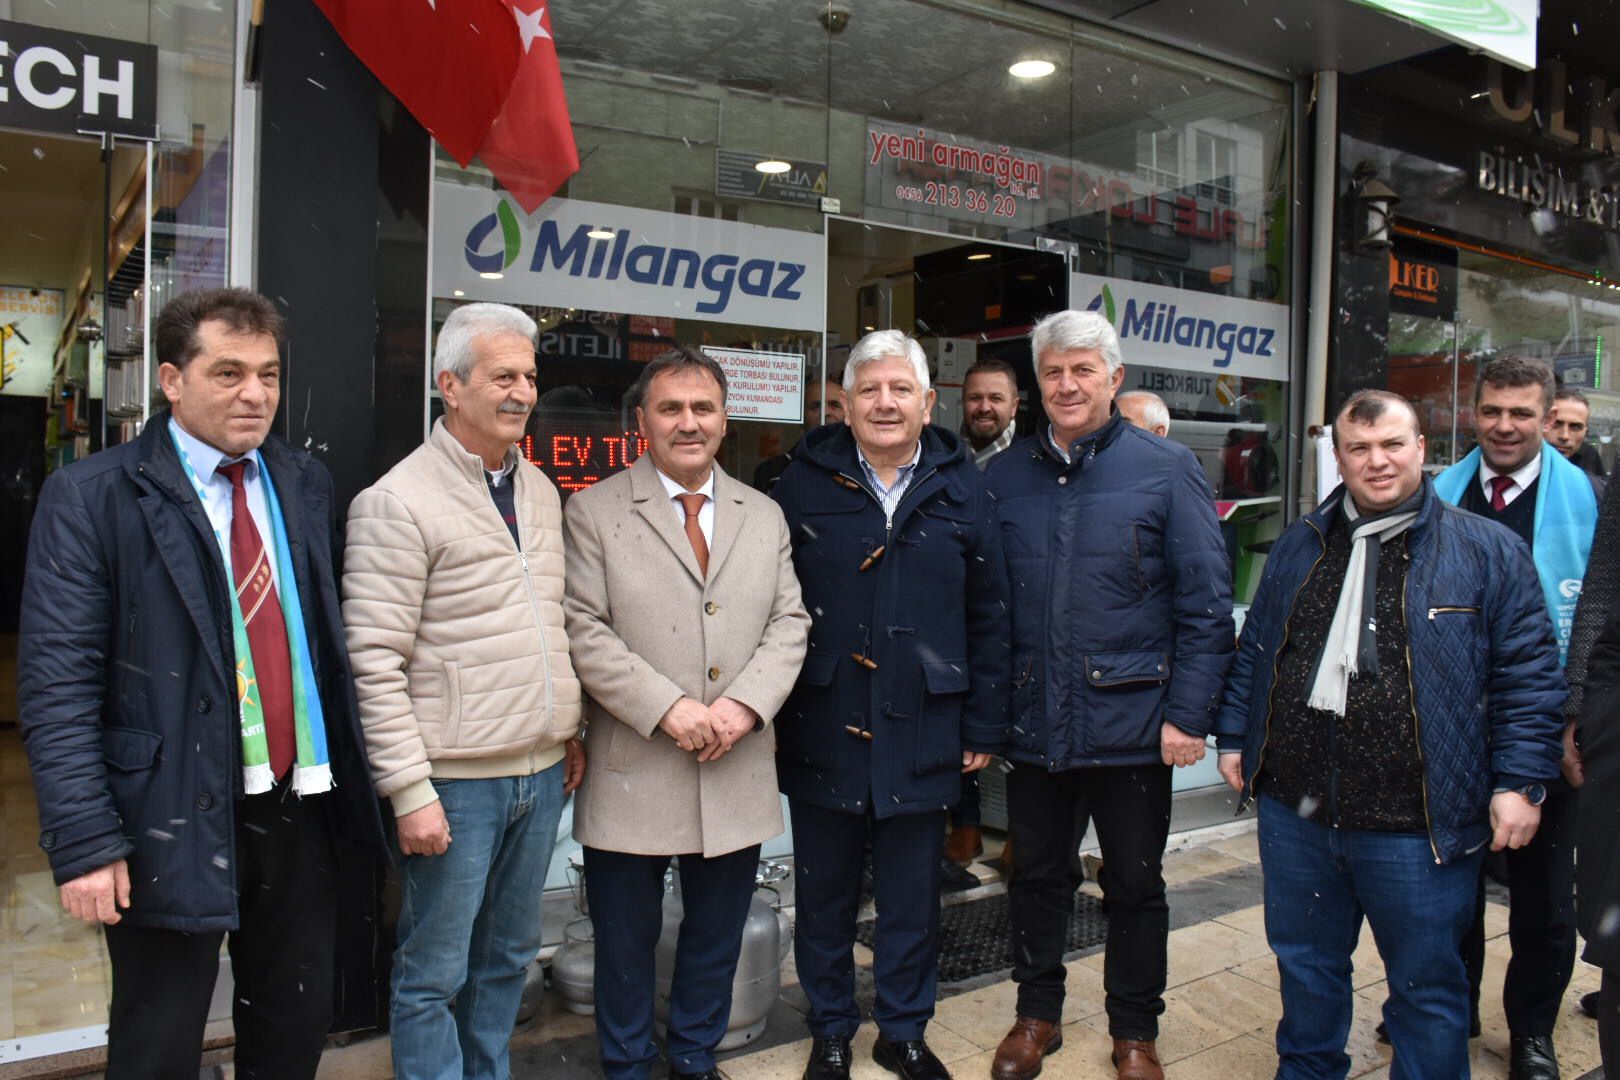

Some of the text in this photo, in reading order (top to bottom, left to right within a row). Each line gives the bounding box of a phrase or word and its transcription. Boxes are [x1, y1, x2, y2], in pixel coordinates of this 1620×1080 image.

[0, 42, 134, 120] CH
[869, 128, 1040, 188] yeni armağan
[896, 181, 1016, 218] 0456 213 36 20
[529, 219, 805, 314] Milangaz
[1121, 298, 1275, 368] Milangaz
[733, 381, 771, 392] KURULUMU
[740, 369, 767, 380] TORBASI
[726, 392, 784, 404] ZYON KUMANDASI
[553, 435, 592, 467] EV
[602, 431, 649, 468] TÜ
